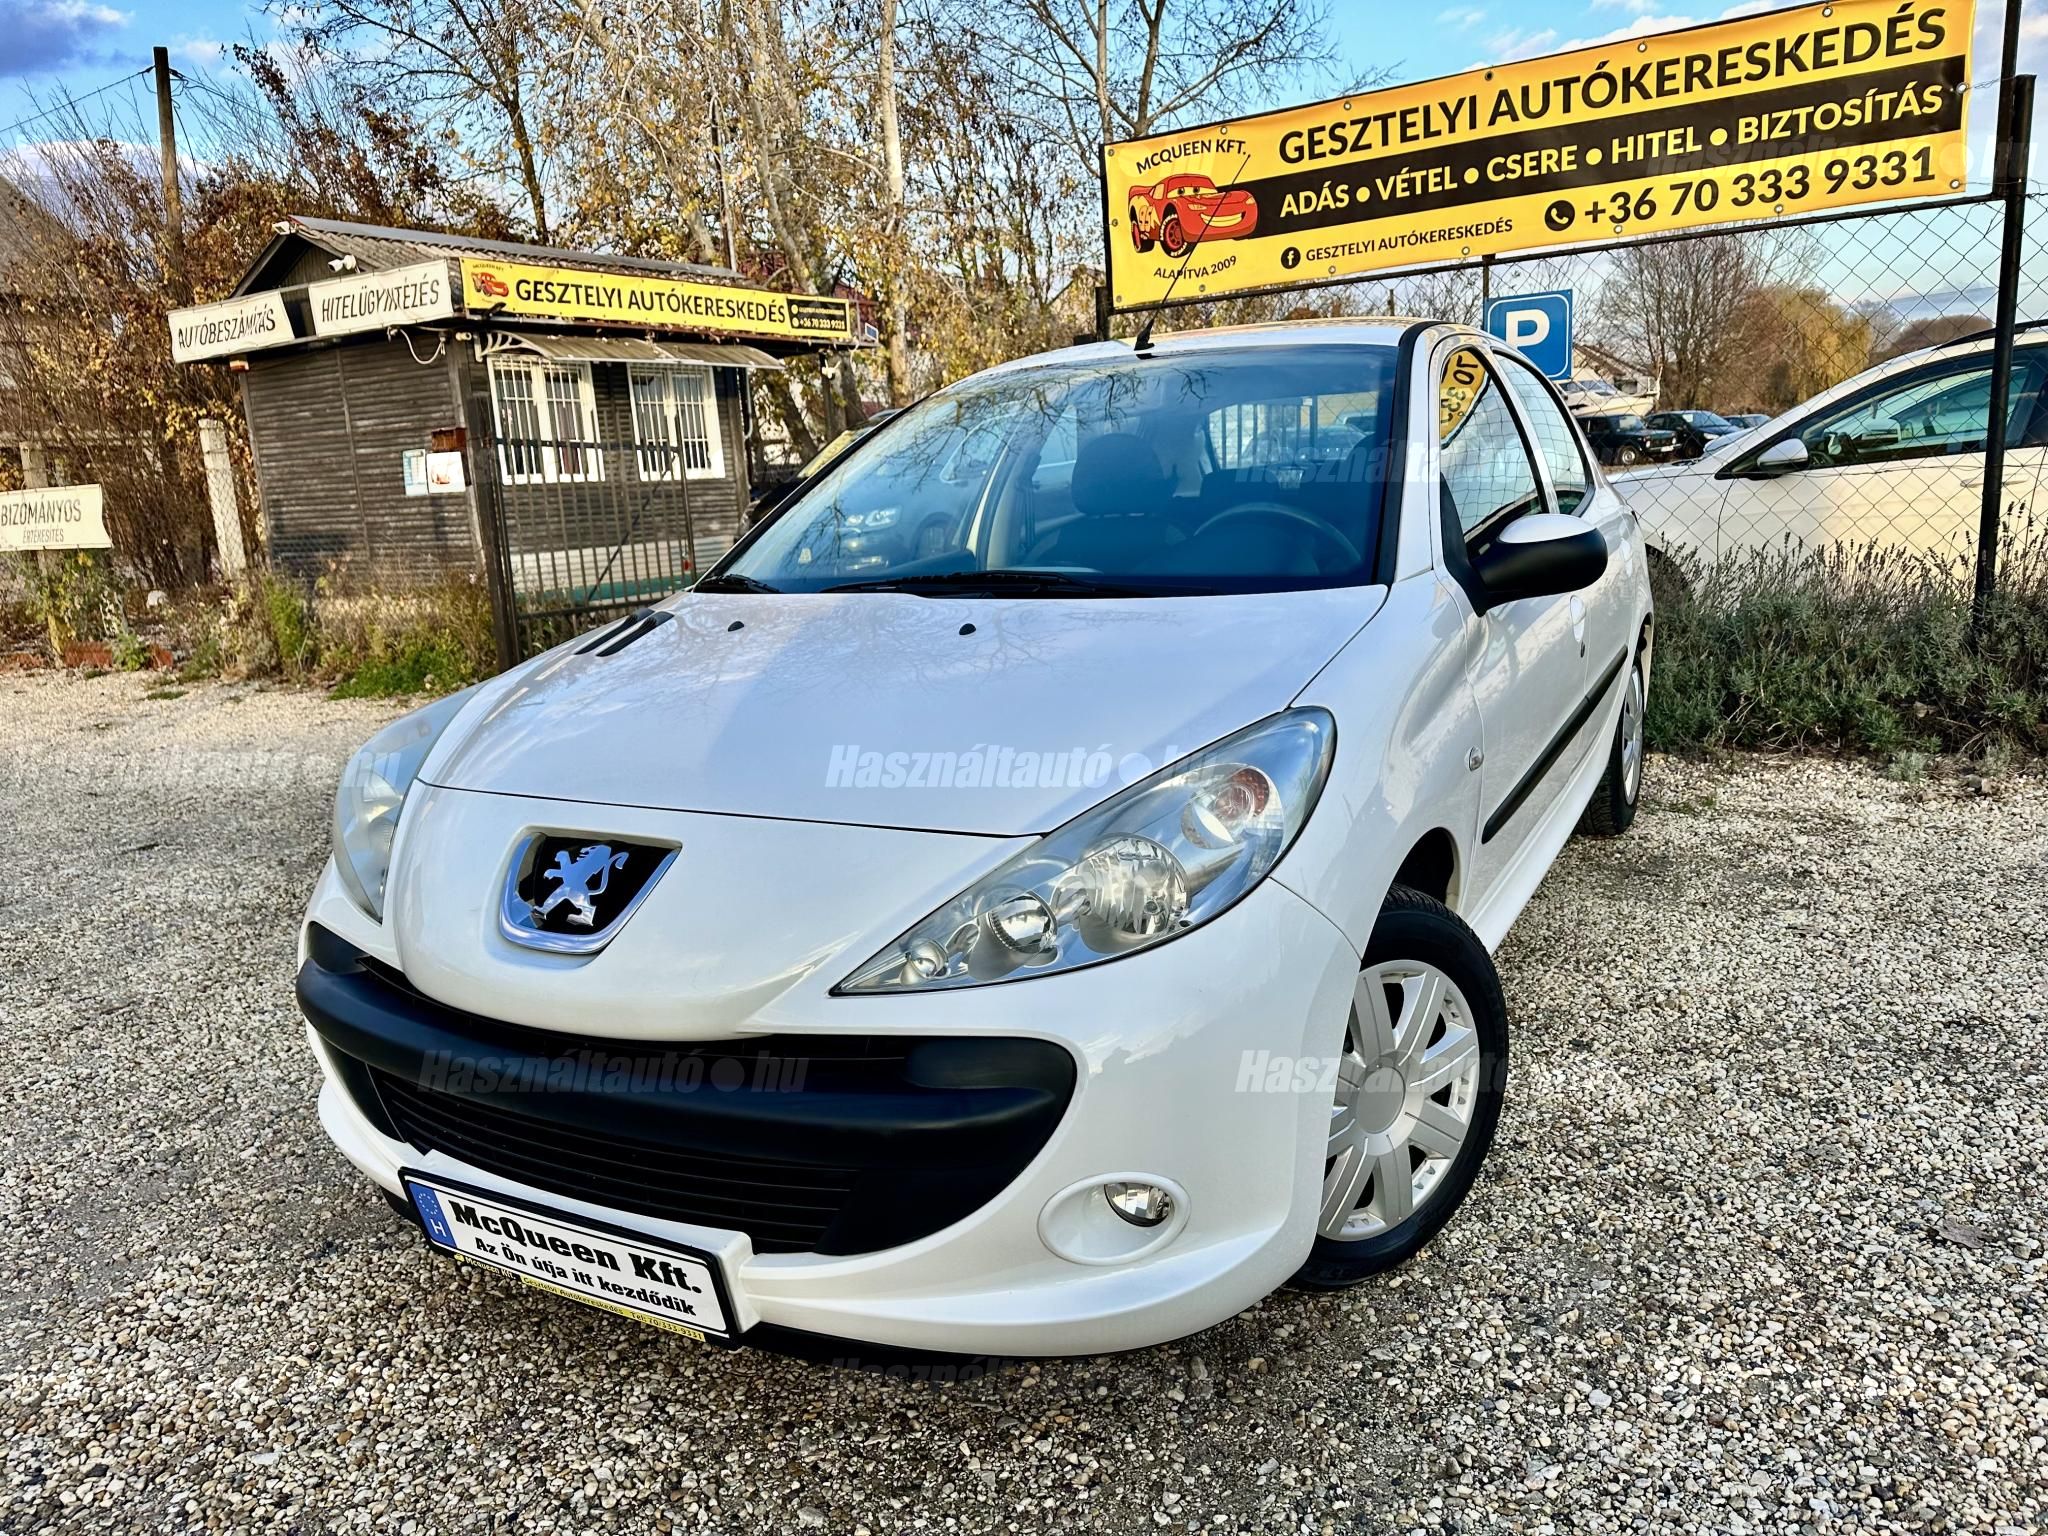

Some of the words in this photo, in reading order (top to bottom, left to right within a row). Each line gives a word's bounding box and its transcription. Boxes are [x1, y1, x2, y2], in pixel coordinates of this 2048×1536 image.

[1279, 94, 1477, 164] GESZTELYI
[1488, 2, 1946, 126] AUTÓKERESKEDÉS
[1136, 139, 1211, 174] MCQUEEN
[1215, 138, 1247, 156] KFT.
[1280, 181, 1350, 218] ADÁS
[1375, 167, 1457, 201] VÉTEL
[1486, 145, 1578, 182] CSERE
[1611, 126, 1702, 164] HITEL
[1737, 81, 1943, 145] BIZTOSÍTÁS
[1584, 186, 1657, 224] +36
[1669, 178, 1720, 216] 70
[1731, 164, 1811, 207] 333
[1824, 146, 1936, 195] 9331
[1306, 239, 1376, 262] GESZTELYI
[1378, 217, 1514, 251] AUTÓKERESKEDÉS
[1153, 266, 1209, 280] ALAPÍTVA
[1210, 254, 1238, 275] 2009
[321, 273, 440, 322] HITELÜGYINTÉZÉS
[515, 278, 623, 310] GESZTELYI
[628, 287, 786, 324] AUTÓKERESKEDÉS
[178, 303, 276, 349] AUTÓBESZÁMÍTÁS
[1505, 308, 1550, 350] P
[1, 494, 82, 527] BIZOMÁNYOS
[430, 1218, 447, 1238] H
[448, 1200, 621, 1271] McQueen
[628, 1253, 702, 1294] Kft.
[475, 1237, 498, 1256] Az
[500, 1242, 528, 1266] Ön
[530, 1256, 569, 1279] útja
[571, 1268, 595, 1287] itt
[597, 1275, 697, 1316] kezdődik
